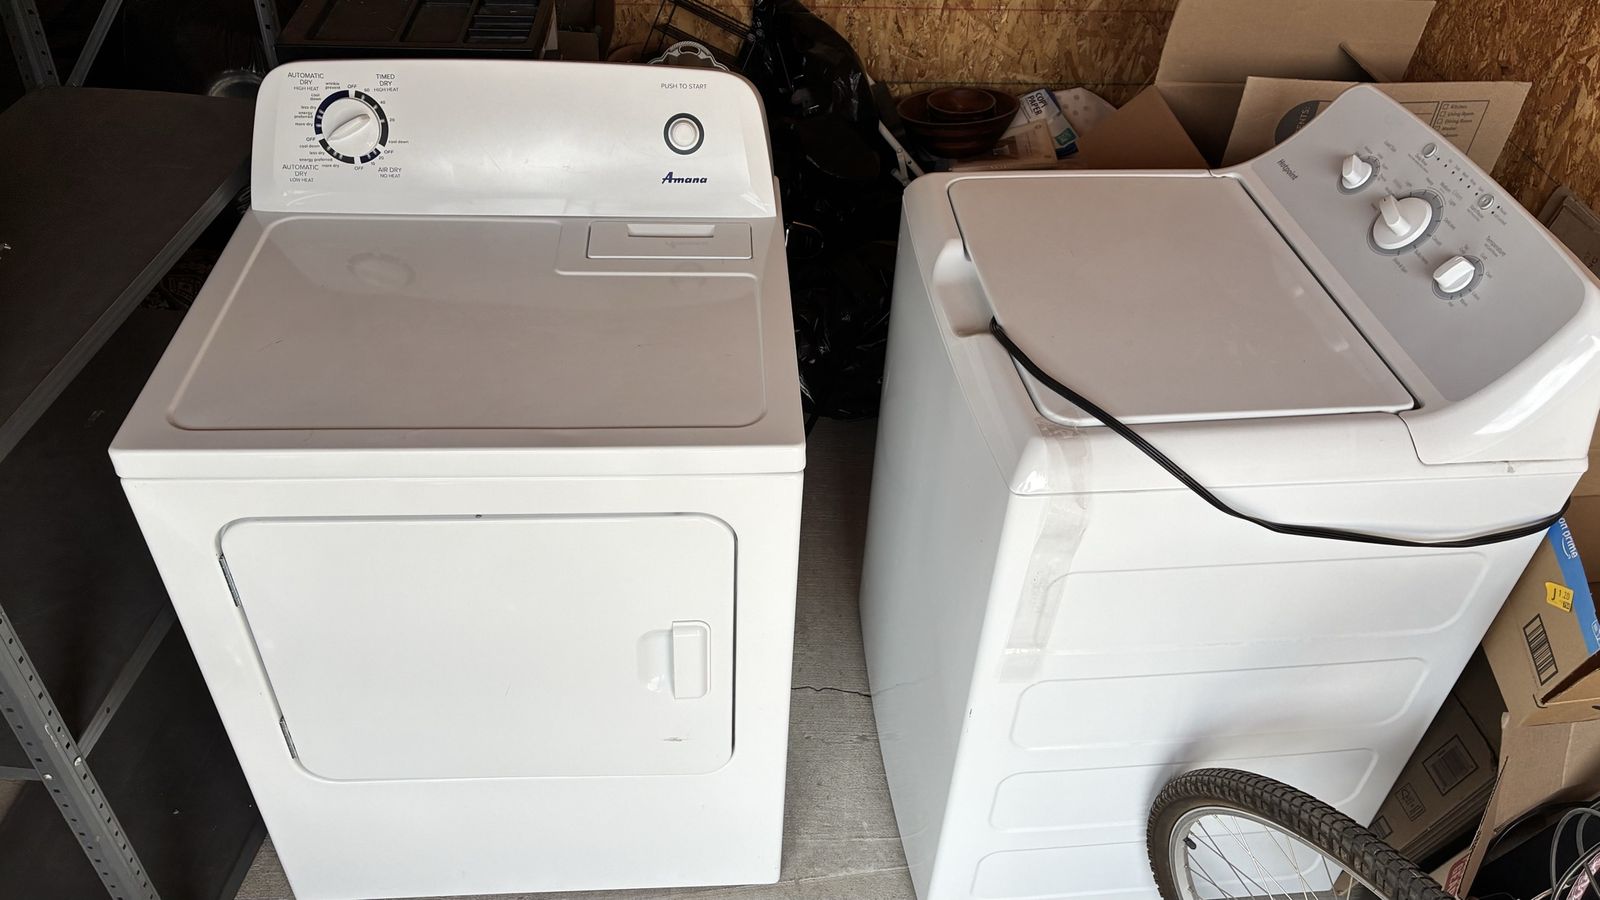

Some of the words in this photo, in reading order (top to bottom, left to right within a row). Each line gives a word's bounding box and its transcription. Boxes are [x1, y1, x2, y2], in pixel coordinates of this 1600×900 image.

[1028, 95, 1042, 115] PAPER
[1036, 92, 1047, 108] COPY
[661, 171, 708, 184] Amana
[1277, 159, 1298, 181] Hotpoint
[1562, 530, 1578, 559] prime
[1551, 588, 1557, 601] J
